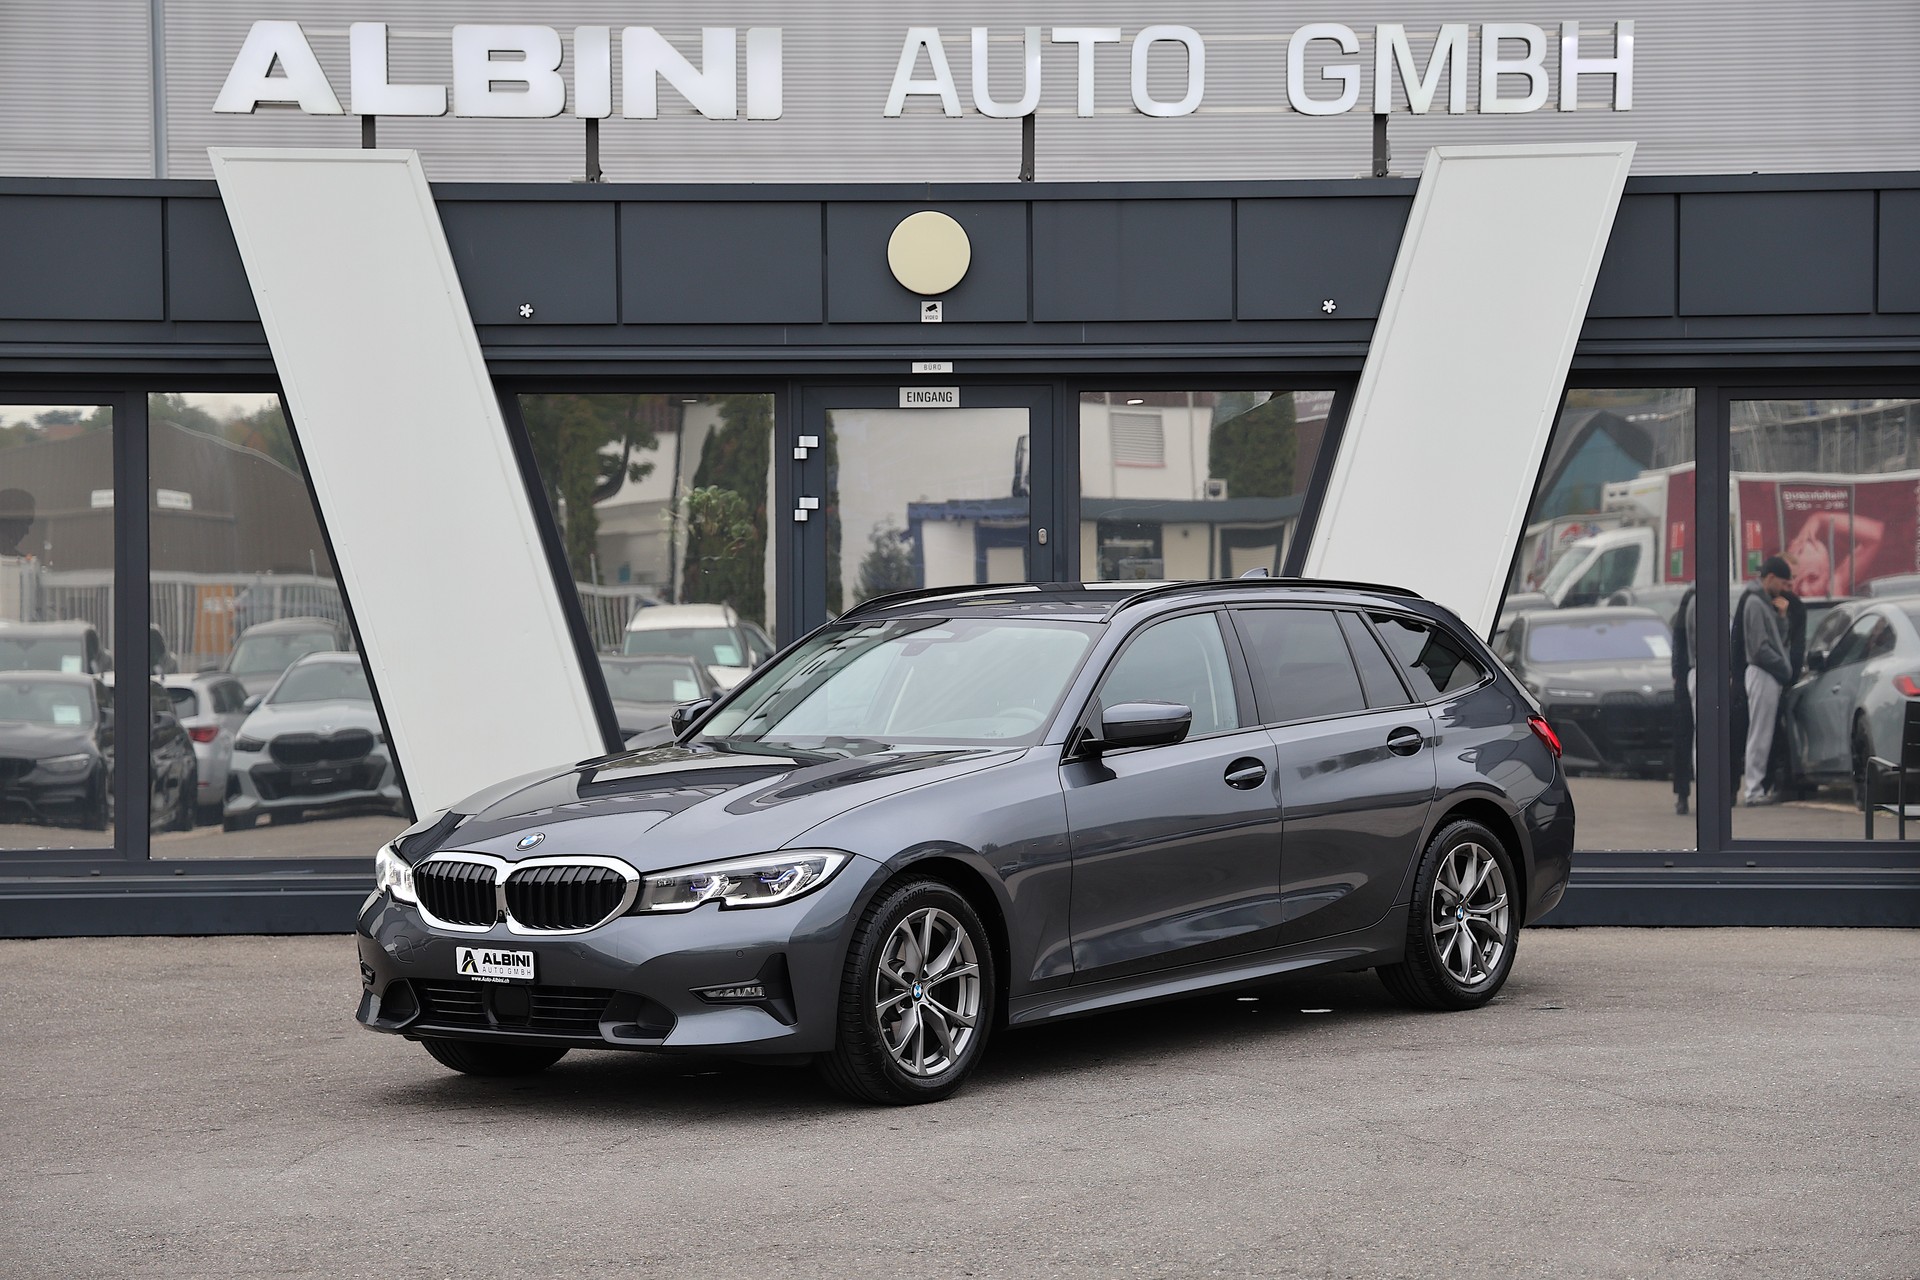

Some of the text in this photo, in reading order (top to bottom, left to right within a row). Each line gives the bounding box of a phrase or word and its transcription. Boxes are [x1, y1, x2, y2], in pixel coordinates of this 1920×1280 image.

[212, 20, 1636, 120] ALBINI AUTO GMBH
[906, 391, 953, 403] EINGANG
[482, 952, 531, 968] ALBINI
[482, 966, 532, 976] AUTO GMBH
